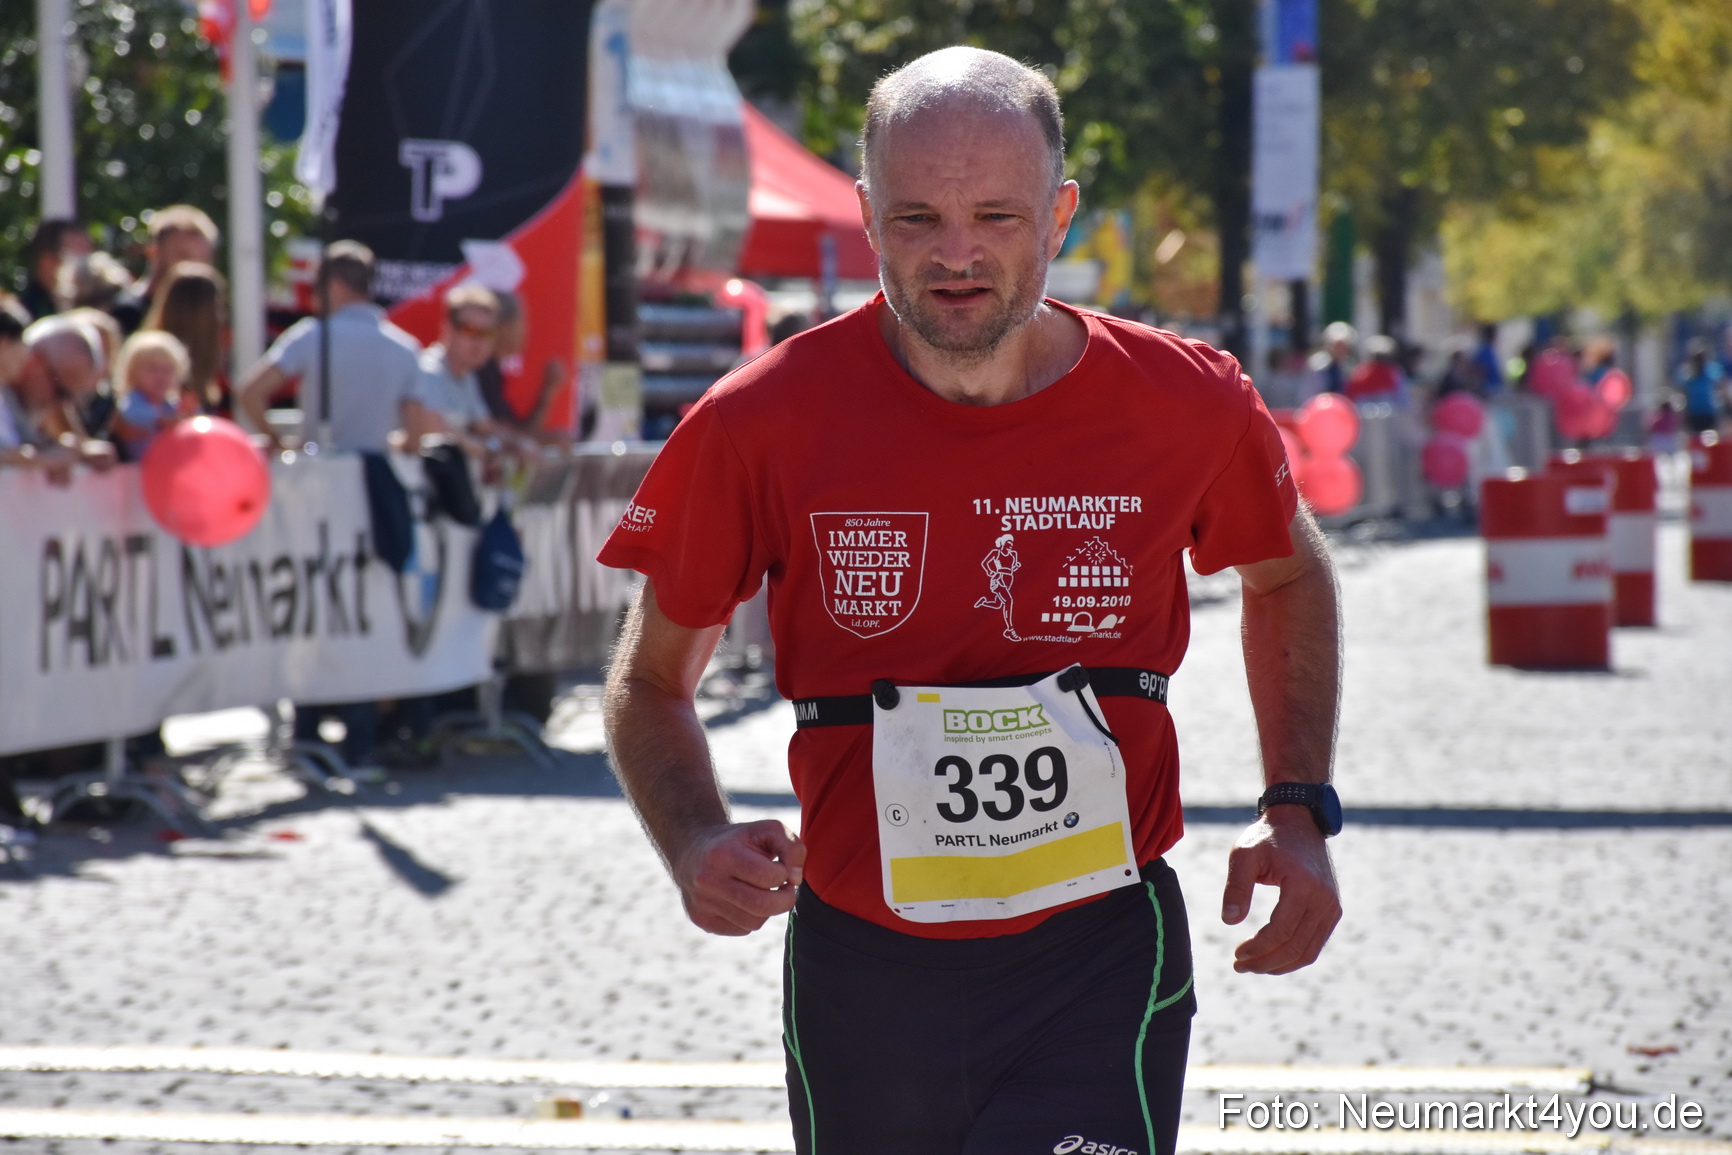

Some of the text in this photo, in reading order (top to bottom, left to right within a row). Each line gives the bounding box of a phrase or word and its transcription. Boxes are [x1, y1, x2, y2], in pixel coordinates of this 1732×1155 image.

[1005, 496, 1142, 513] NEUMARKTER
[618, 520, 653, 532] CHAFT
[845, 518, 891, 527] 850 Jahre
[1001, 513, 1116, 531] STADTLAUF
[828, 530, 908, 547] IMMER
[826, 550, 911, 567] WIEDER
[834, 570, 903, 596] NEU
[39, 533, 176, 673] PARTL
[834, 599, 902, 616] MARKT
[1052, 595, 1131, 608] 19.09.2010
[943, 703, 1050, 734] BOCK
[944, 727, 1053, 744] inspired by smart concepts
[934, 746, 1068, 823] 339
[892, 809, 902, 822] C
[935, 820, 1059, 847] PARTL Neumarkt
[1080, 1141, 1138, 1155] asic
